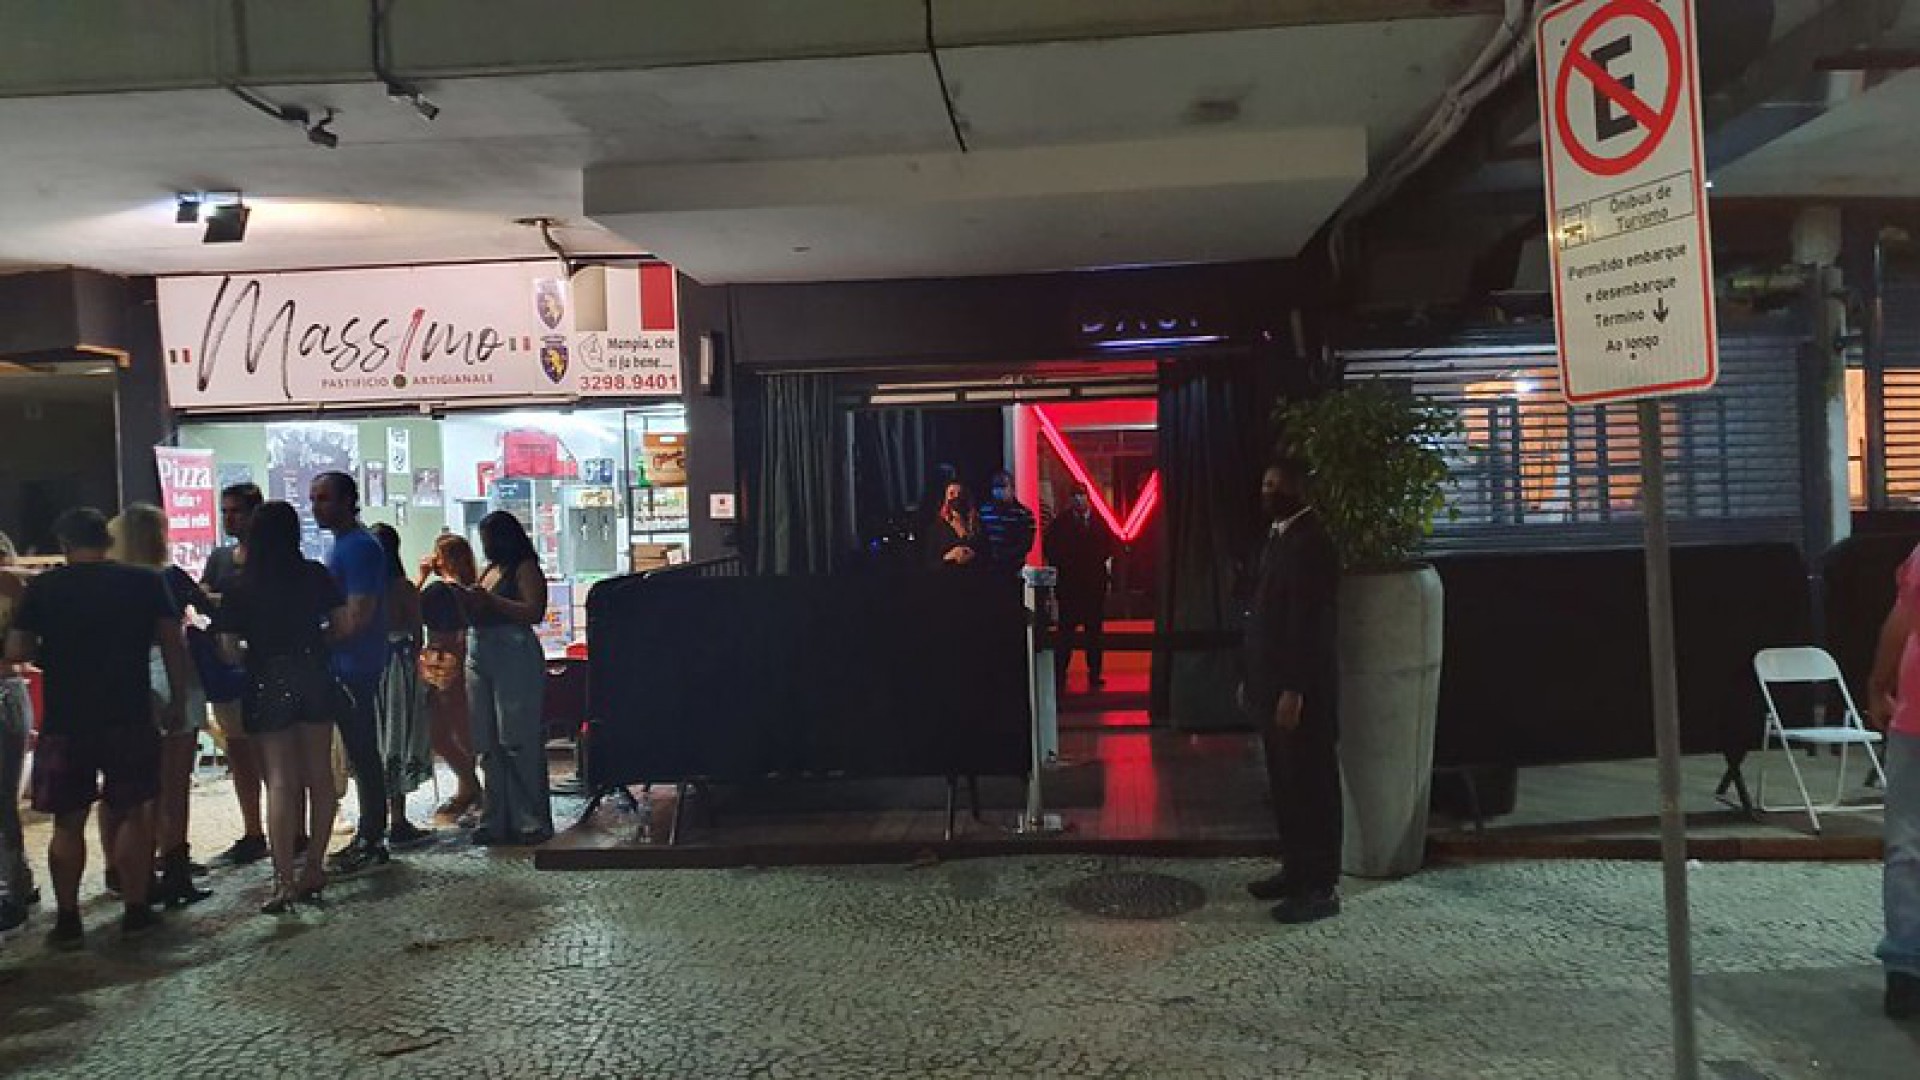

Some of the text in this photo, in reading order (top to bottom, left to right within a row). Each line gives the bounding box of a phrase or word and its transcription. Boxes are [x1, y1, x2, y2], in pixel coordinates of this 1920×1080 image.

[1591, 34, 1637, 142] E
[1610, 185, 1671, 213] Ônibus de
[1617, 207, 1669, 232] Turismo
[1568, 244, 1687, 281] Permitido embarque
[1585, 277, 1676, 303] e desembarque
[655, 336, 675, 349] che
[1606, 335, 1659, 352] Ao longo
[321, 374, 493, 389] PASTIFICIO ARTIGIANALE
[579, 374, 678, 391] 3298.9401
[159, 458, 212, 488] Pizza
